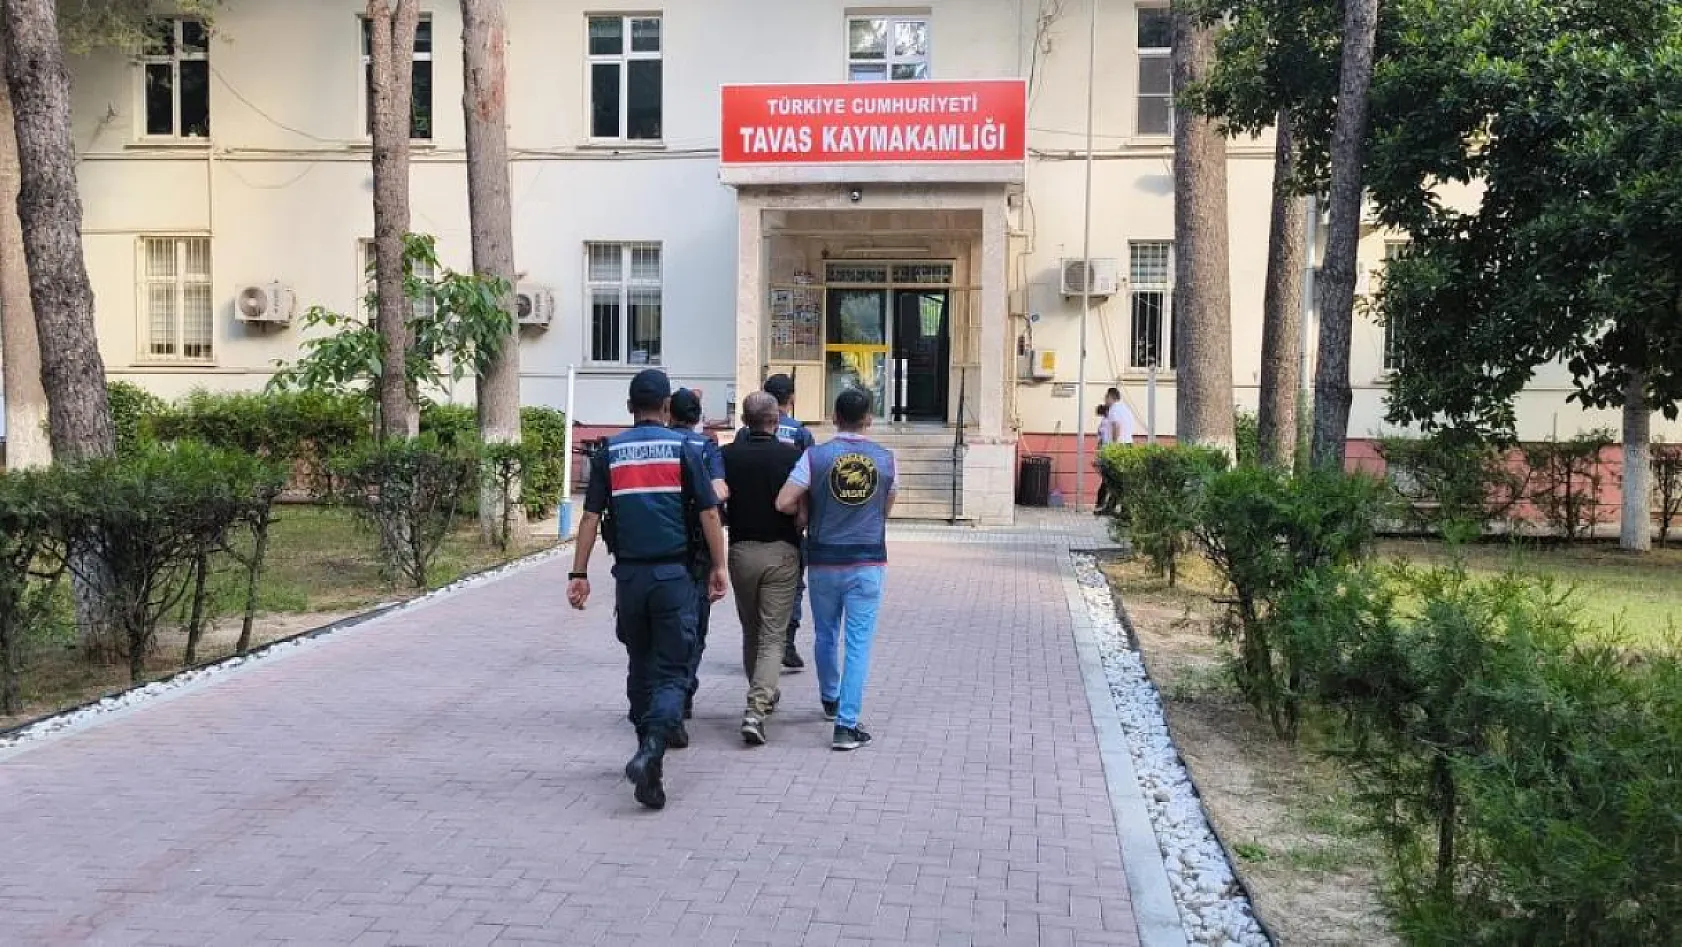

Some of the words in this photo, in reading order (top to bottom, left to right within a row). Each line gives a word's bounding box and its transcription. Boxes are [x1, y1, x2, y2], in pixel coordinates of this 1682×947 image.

[767, 94, 845, 115] TÜRKİYE
[851, 93, 978, 114] CUMHURİYETİ
[740, 126, 812, 153] TAVAS
[822, 117, 1005, 152] KAYMAKAMLIĞI
